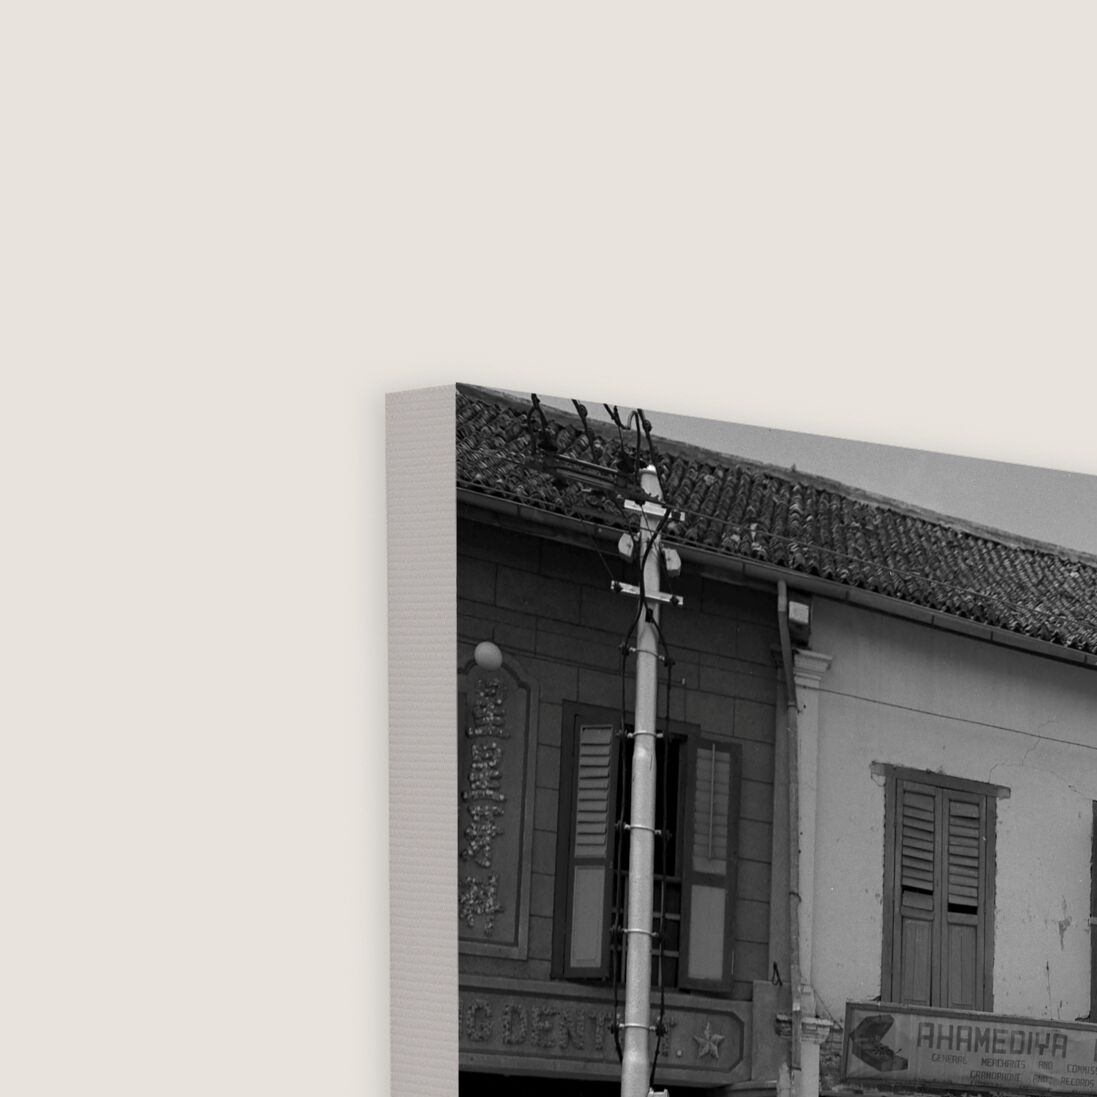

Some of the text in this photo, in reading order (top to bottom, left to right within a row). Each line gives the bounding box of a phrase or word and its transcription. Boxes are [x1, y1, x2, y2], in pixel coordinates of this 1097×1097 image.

[916, 1021, 1069, 1059] AHAMEDIYA
[931, 1052, 968, 1066] GENERAL
[980, 1056, 1026, 1070] MERCHANTS
[1037, 1059, 1054, 1071] AND
[969, 1069, 1022, 1083] GRAMOPHONE
[1060, 1075, 1096, 1089] RECORDS
